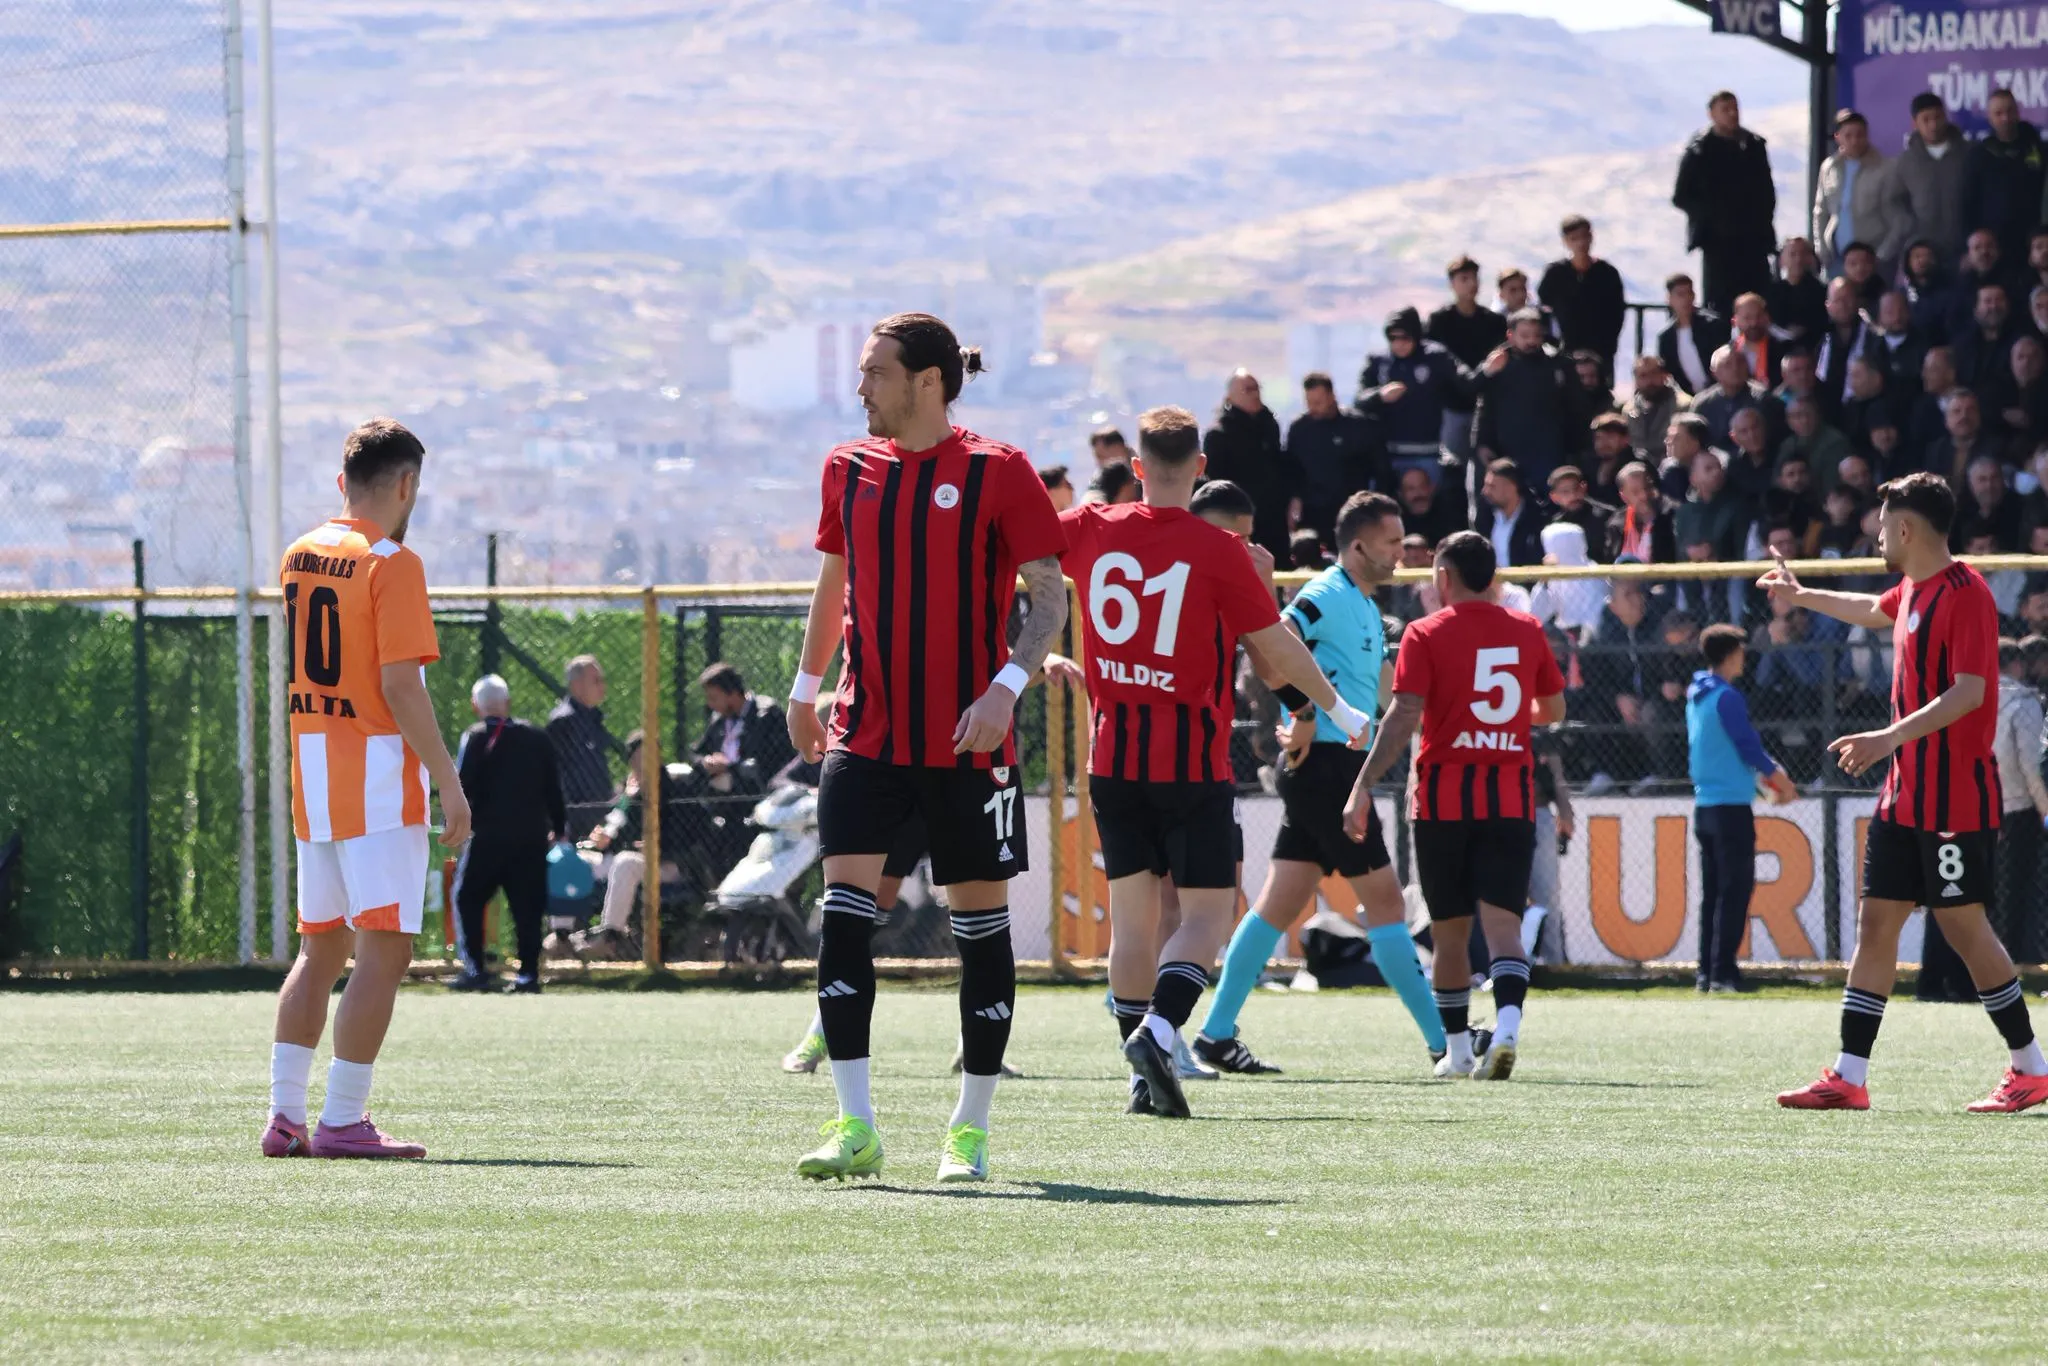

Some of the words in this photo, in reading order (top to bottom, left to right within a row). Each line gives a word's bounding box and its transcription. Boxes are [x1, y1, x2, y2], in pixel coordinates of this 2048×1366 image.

[1718, 0, 1775, 35] WC
[1927, 62, 1989, 113] TÜM
[1088, 551, 1191, 657] 61
[284, 582, 342, 687] 10
[1096, 656, 1177, 693] YILDIZ
[1469, 646, 1522, 725] 5
[1450, 730, 1524, 752] ANIL
[983, 786, 1017, 841] 17
[1938, 843, 1965, 881] 8
